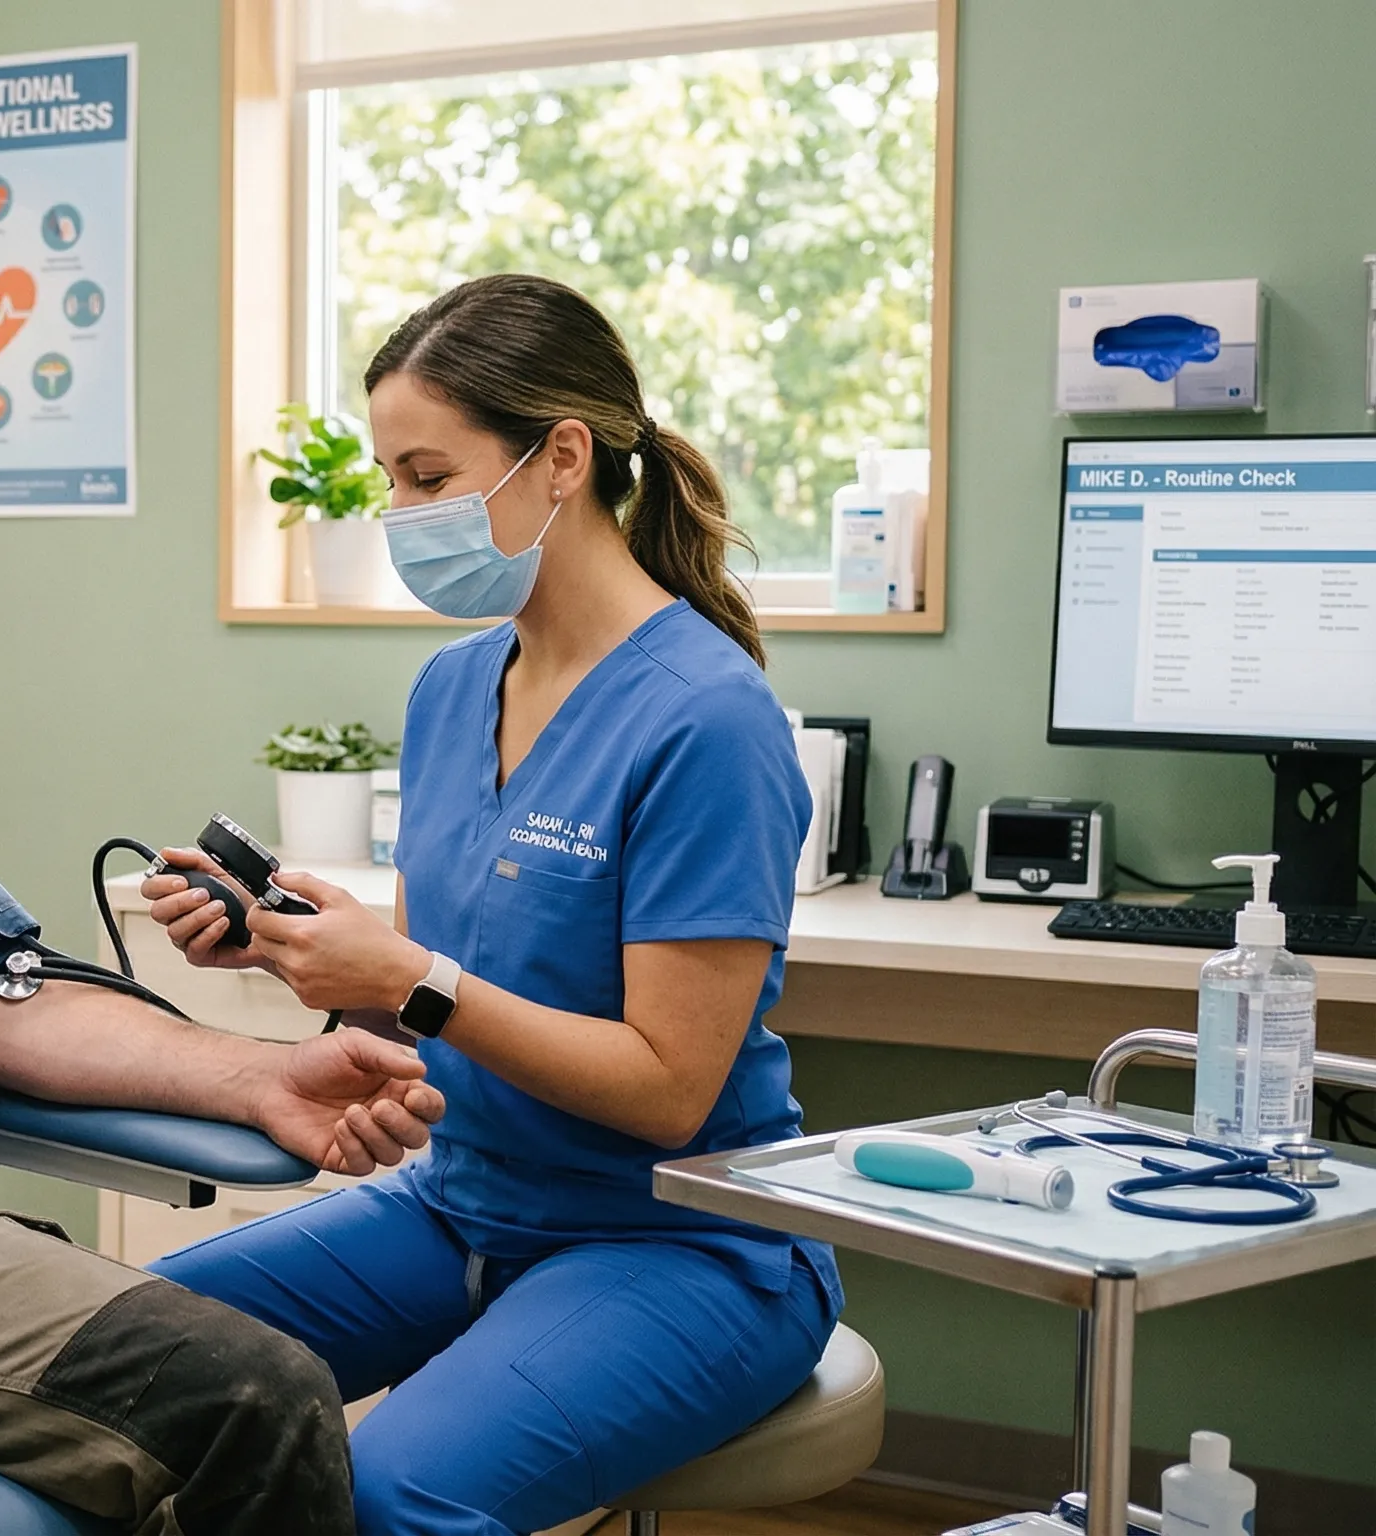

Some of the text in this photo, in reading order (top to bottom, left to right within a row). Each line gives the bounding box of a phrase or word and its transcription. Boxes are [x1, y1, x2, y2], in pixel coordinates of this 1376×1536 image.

[1080, 470, 1125, 487] MIKE
[1130, 470, 1149, 487] D.
[1165, 469, 1234, 487] Routine
[1238, 468, 1297, 487] Check
[527, 812, 563, 833] SARAH
[577, 822, 596, 841] RN
